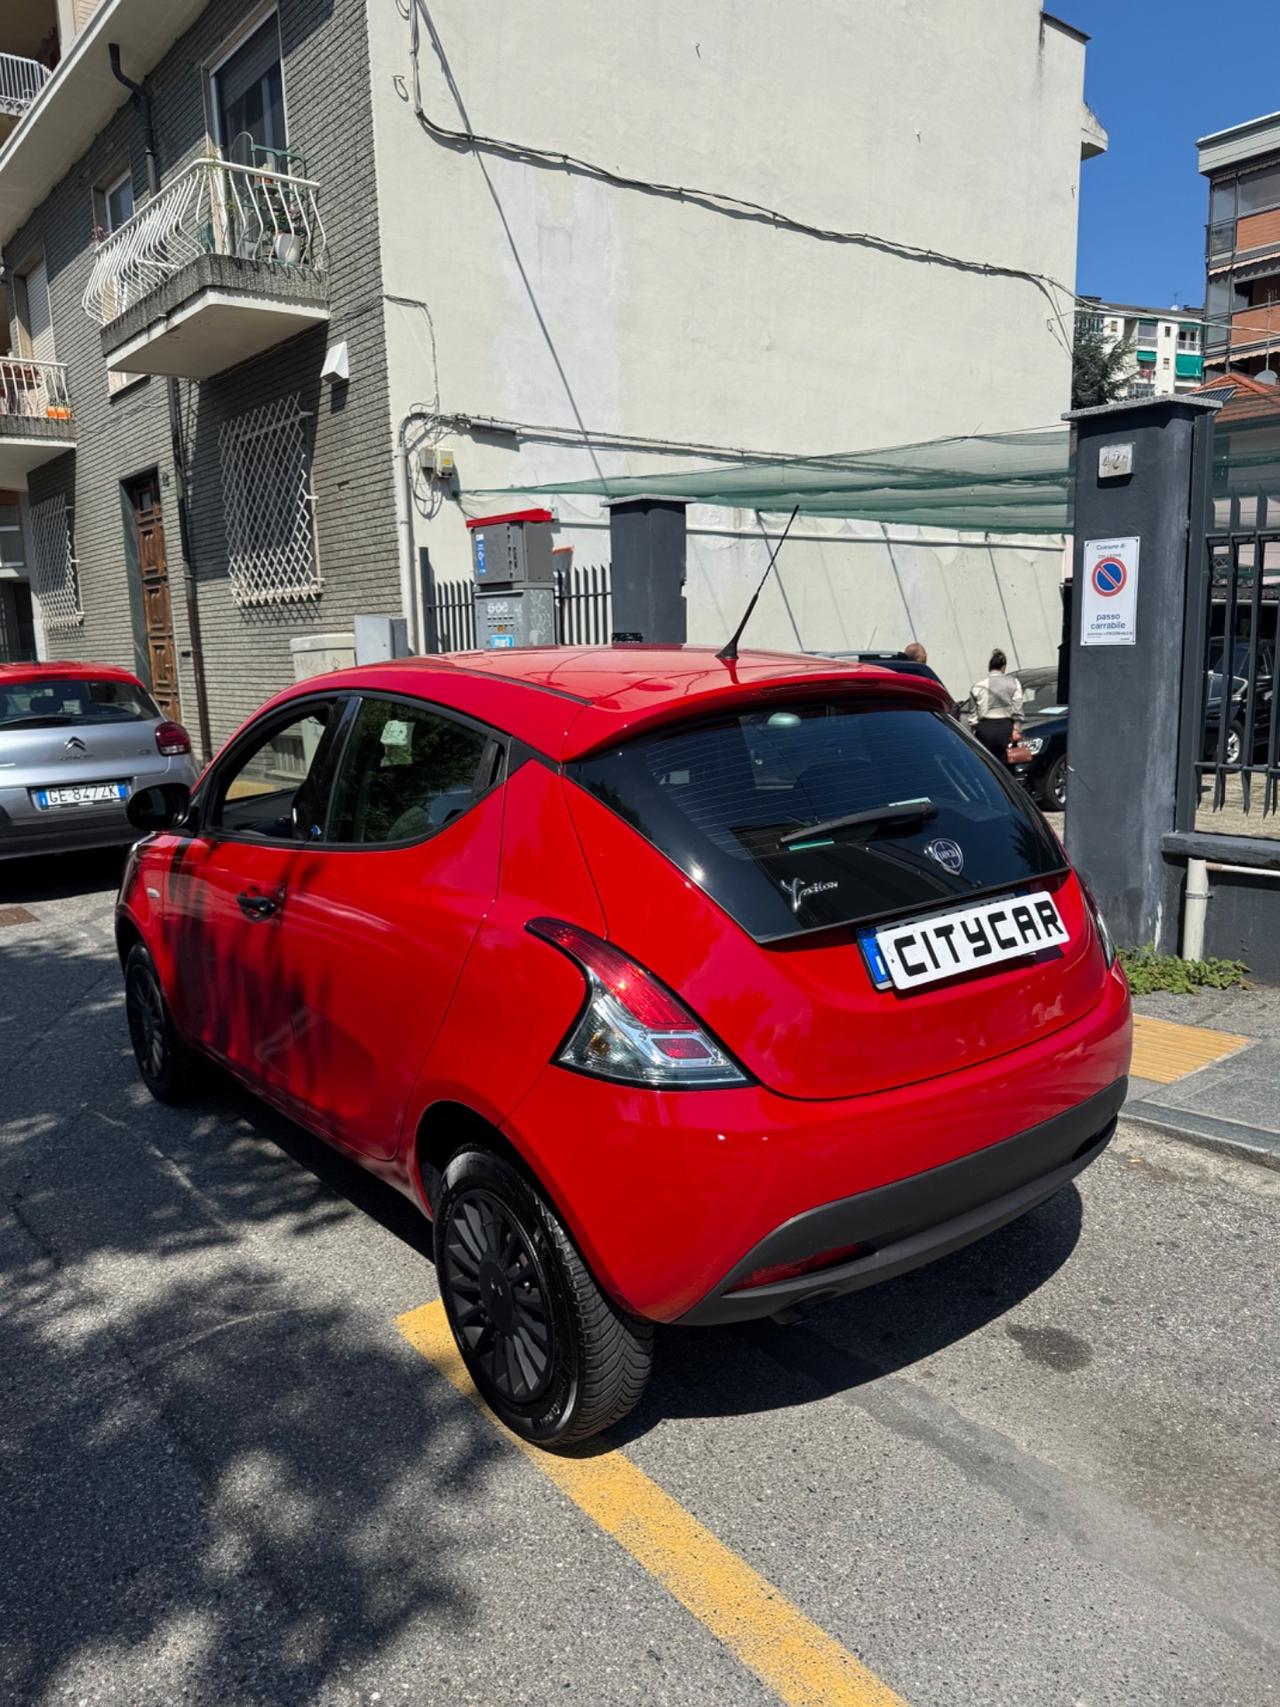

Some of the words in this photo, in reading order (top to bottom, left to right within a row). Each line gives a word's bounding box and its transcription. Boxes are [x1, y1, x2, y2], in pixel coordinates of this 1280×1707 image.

[1096, 613, 1121, 622] passo
[1090, 621, 1126, 630] carrabile
[894, 900, 1064, 977] CITYCAR
